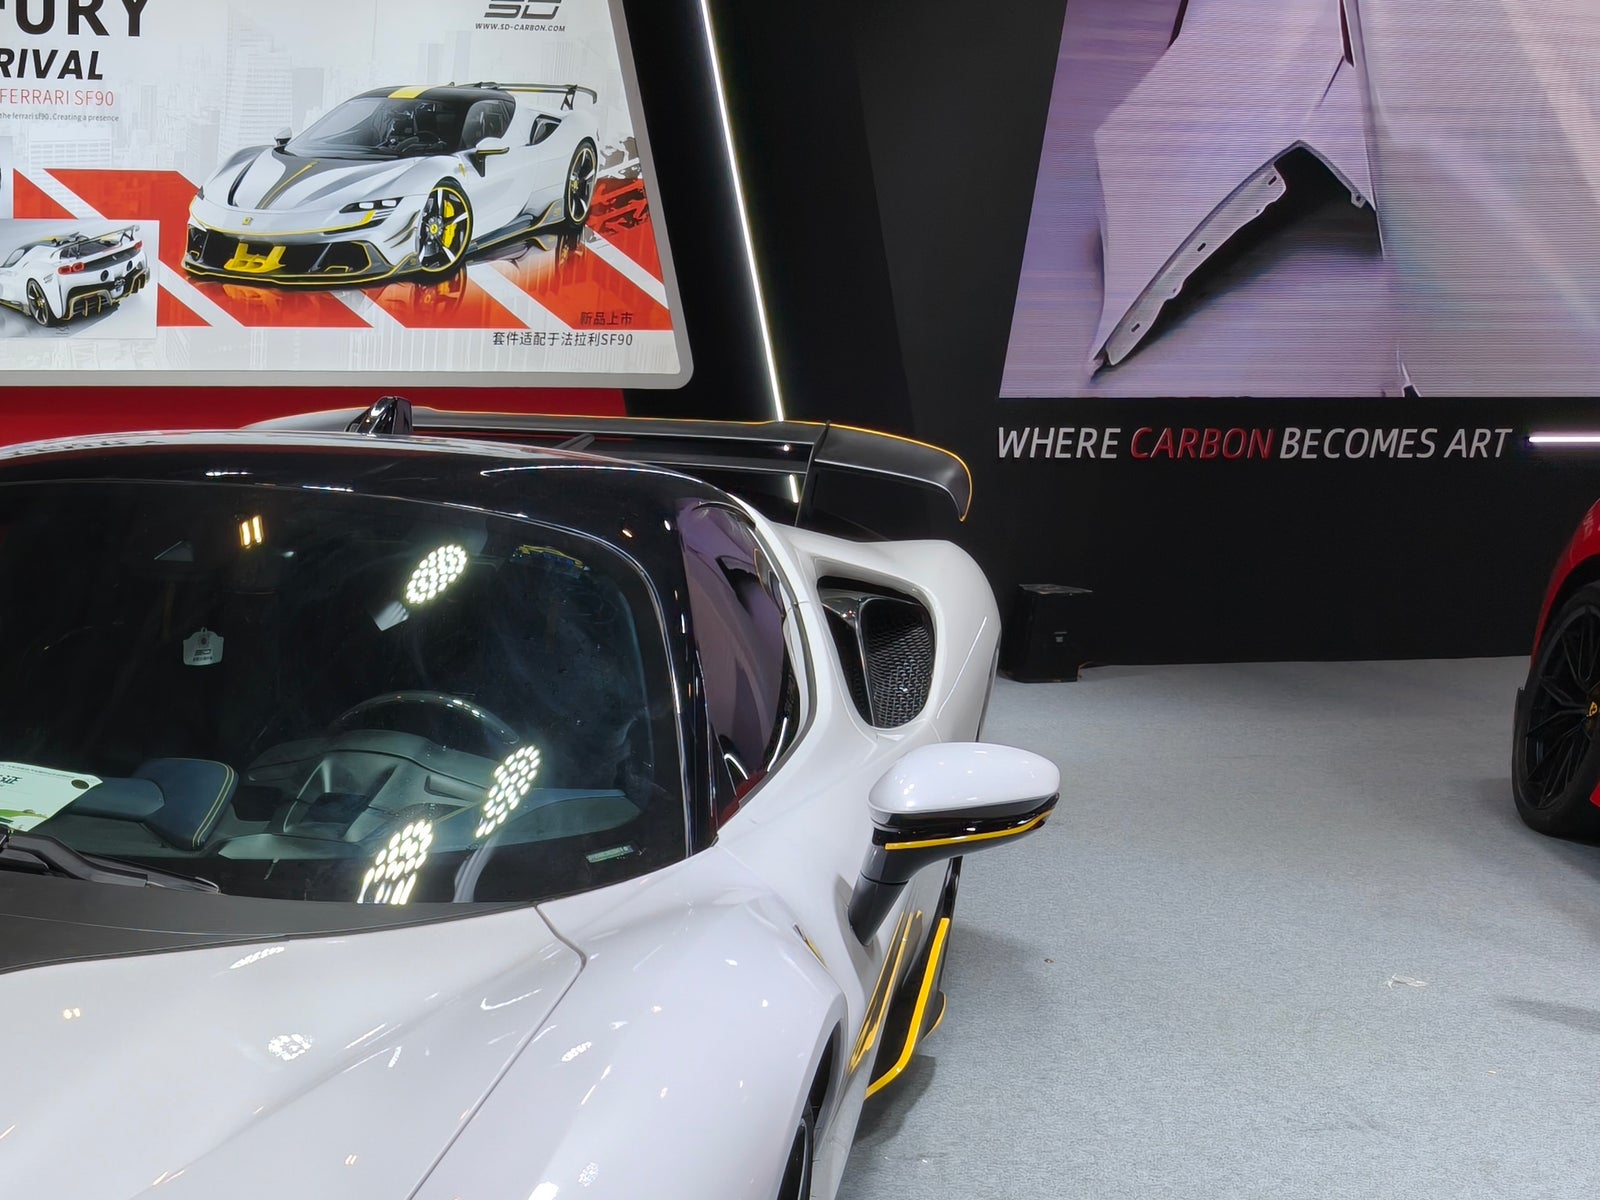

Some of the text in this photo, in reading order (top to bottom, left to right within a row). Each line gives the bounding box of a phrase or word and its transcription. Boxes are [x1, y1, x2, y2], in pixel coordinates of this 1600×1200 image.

[475, 23, 566, 32] WWW.SD-CARBON.COM
[0, 88, 69, 105] FERRARI
[74, 90, 114, 107] SF90
[52, 113, 82, 122] Creating
[88, 115, 119, 123] presence
[580, 312, 634, 326] 新品上市
[493, 332, 633, 347] 套件适配于法拉利SF90
[998, 427, 1512, 460] WHERE CARBON BECOMES ART
